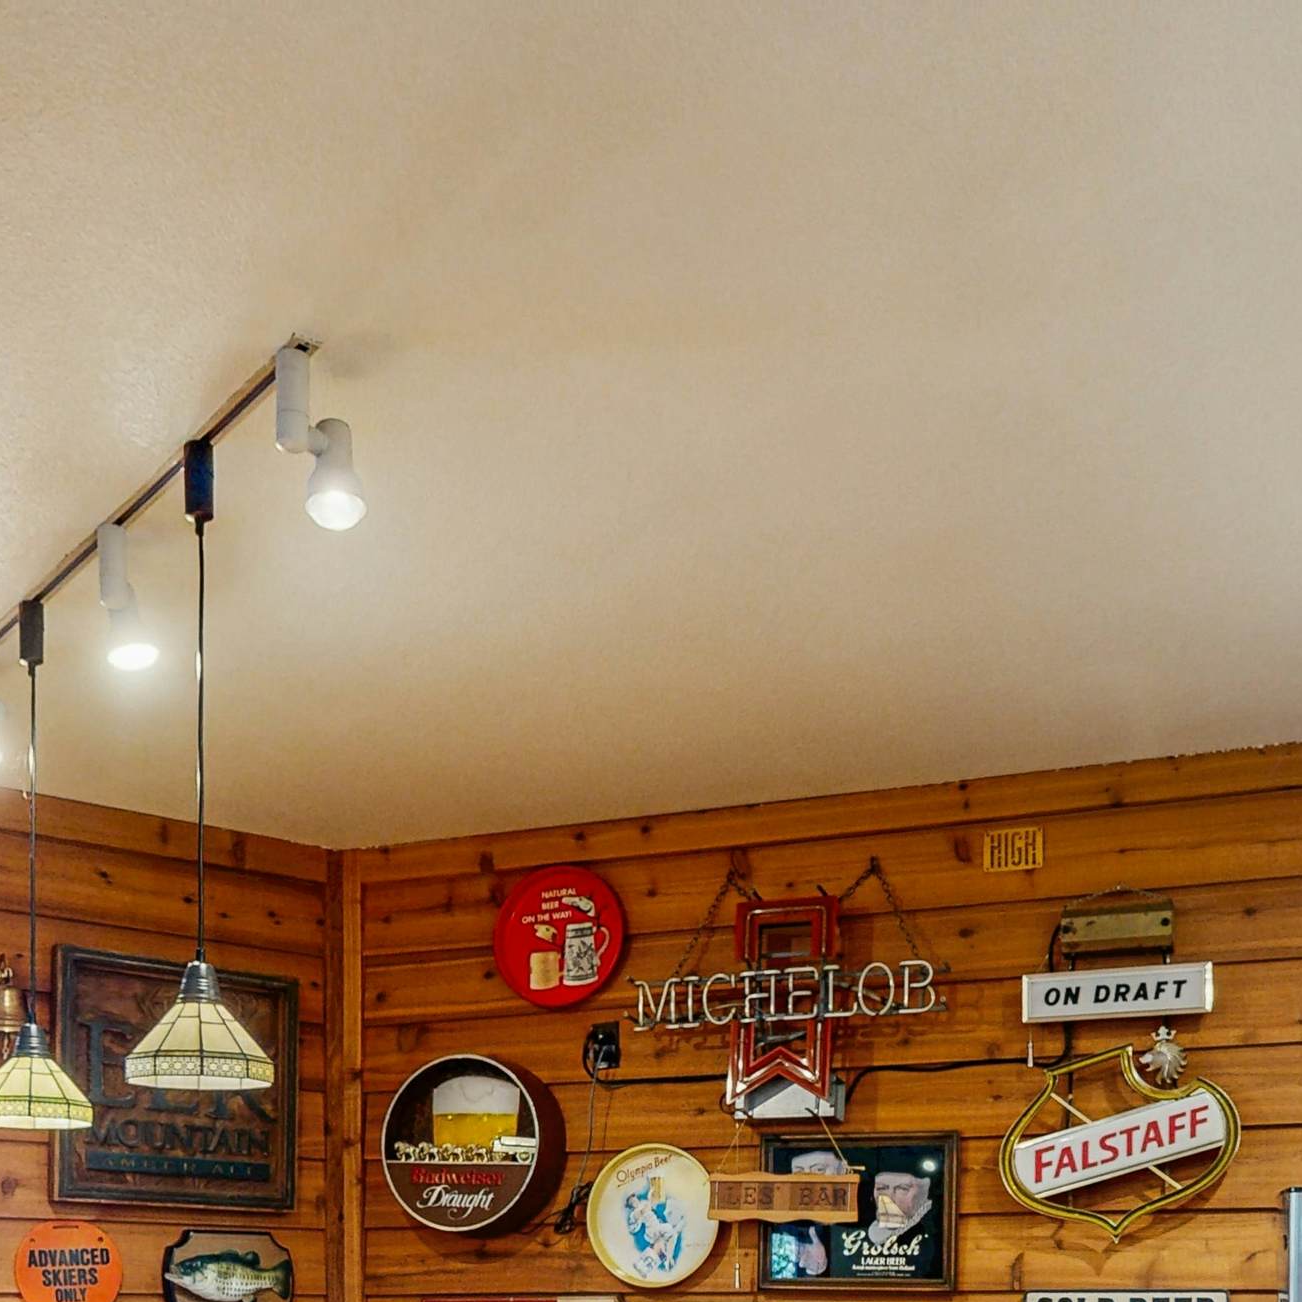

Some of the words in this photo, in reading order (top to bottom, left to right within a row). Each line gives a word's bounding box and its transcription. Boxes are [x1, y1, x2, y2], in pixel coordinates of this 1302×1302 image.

[990, 830, 1036, 868] HIGH
[542, 888, 576, 899] NATURAL
[542, 901, 559, 910] BEER
[522, 915, 535, 924] ON
[537, 913, 550, 922] THE
[1044, 987, 1080, 1006] ON
[1094, 980, 1187, 1003] DRAFT
[84, 1119, 270, 1156] MOUNTAIN
[1034, 1105, 1209, 1184] FALSTAFF
[410, 1166, 506, 1185] Budweiser
[616, 1163, 653, 1183] Olympia
[654, 1154, 673, 1168] Beer
[416, 1184, 495, 1220] Draught
[799, 1187, 847, 1206] BAR
[841, 1229, 923, 1256] Grolsch
[28, 1248, 110, 1267] ADVANCED
[887, 1256, 906, 1266] BEER
[42, 1268, 98, 1287] SKIERS
[55, 1288, 87, 1302] ONLY
